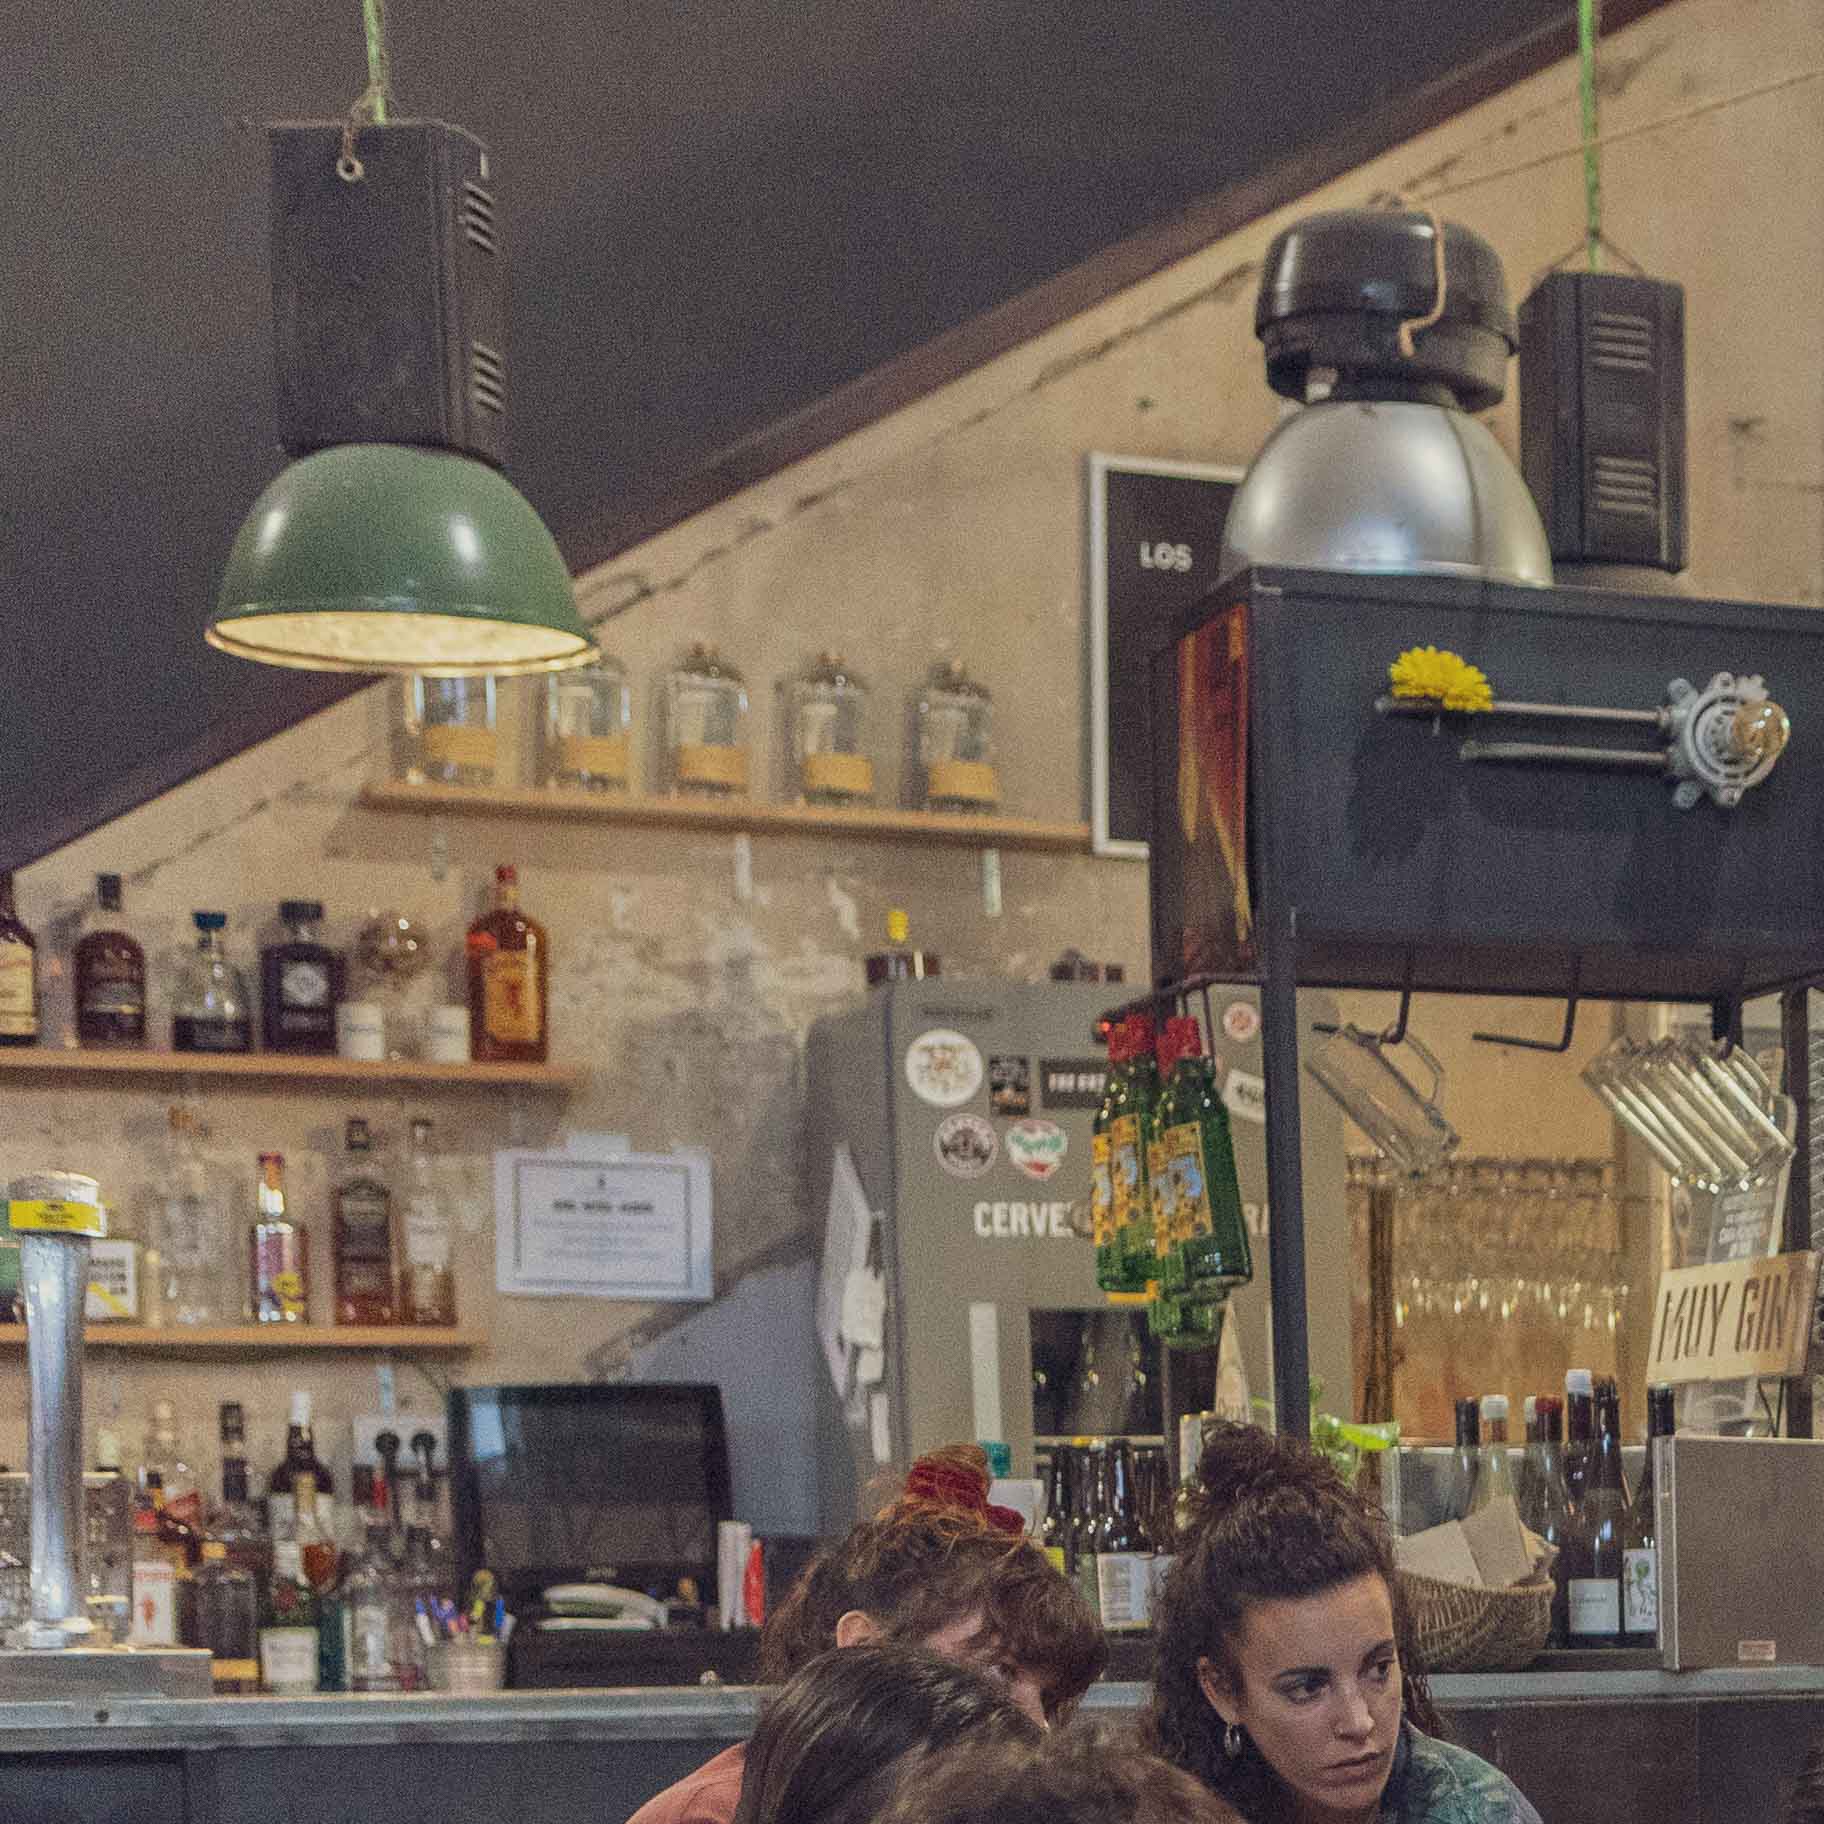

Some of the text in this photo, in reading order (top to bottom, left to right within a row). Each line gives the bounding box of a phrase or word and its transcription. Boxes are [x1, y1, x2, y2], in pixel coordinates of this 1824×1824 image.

[1139, 541, 1194, 573] LOS
[973, 1201, 1073, 1238] CERVE
[1657, 1281, 1731, 1363] MUY
